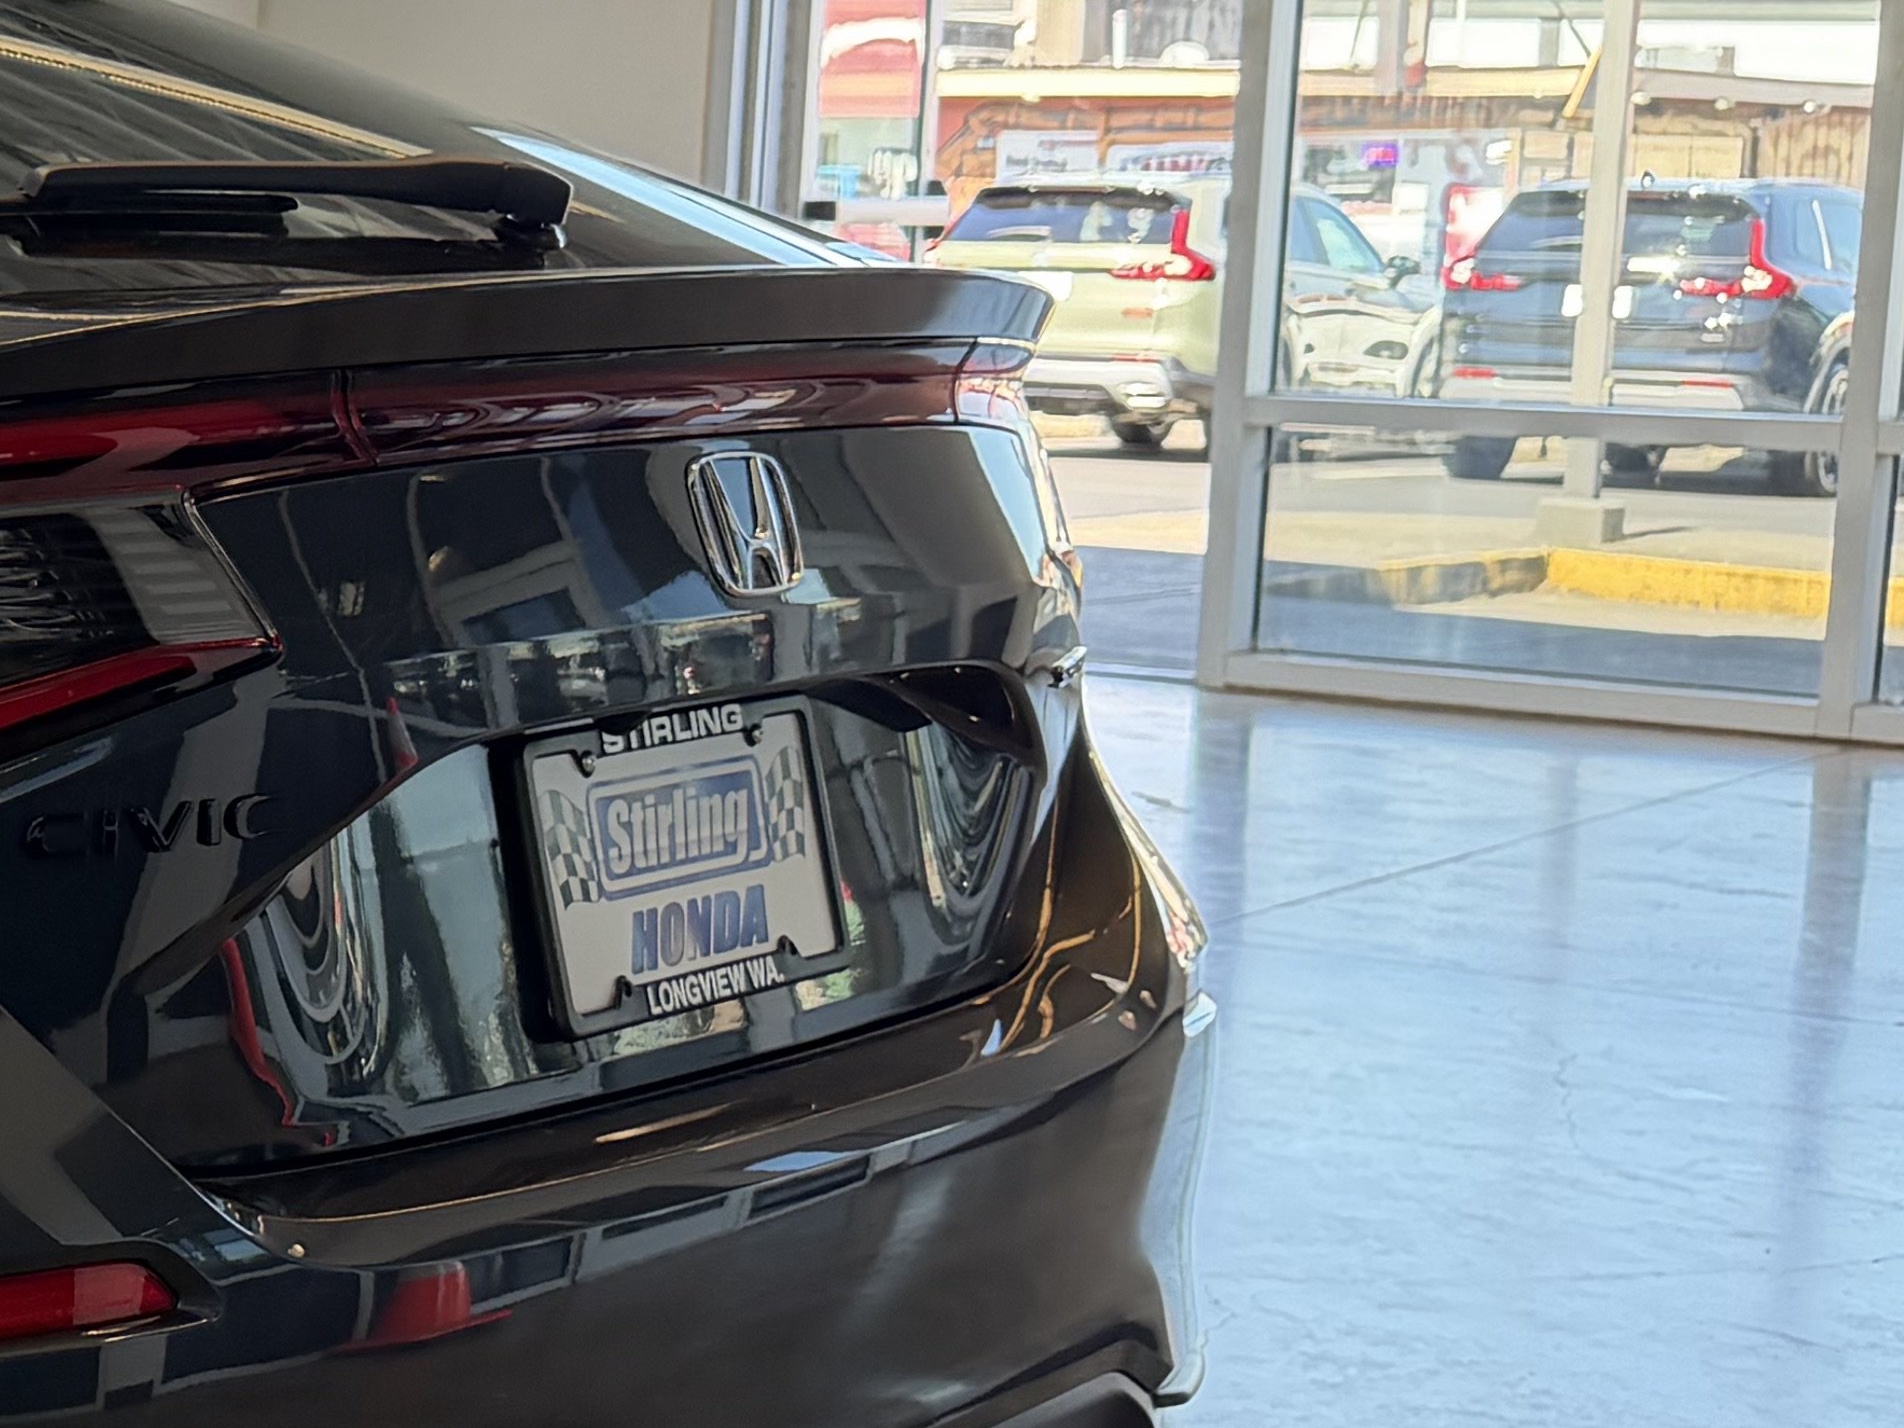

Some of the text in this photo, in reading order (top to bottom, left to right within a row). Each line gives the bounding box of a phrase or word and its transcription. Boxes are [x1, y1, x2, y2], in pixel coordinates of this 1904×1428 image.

[22, 794, 273, 857] CIVIC
[607, 785, 749, 873] Stirling
[632, 884, 769, 975] HONDA
[646, 957, 784, 1016] LONGVIEW WA.
